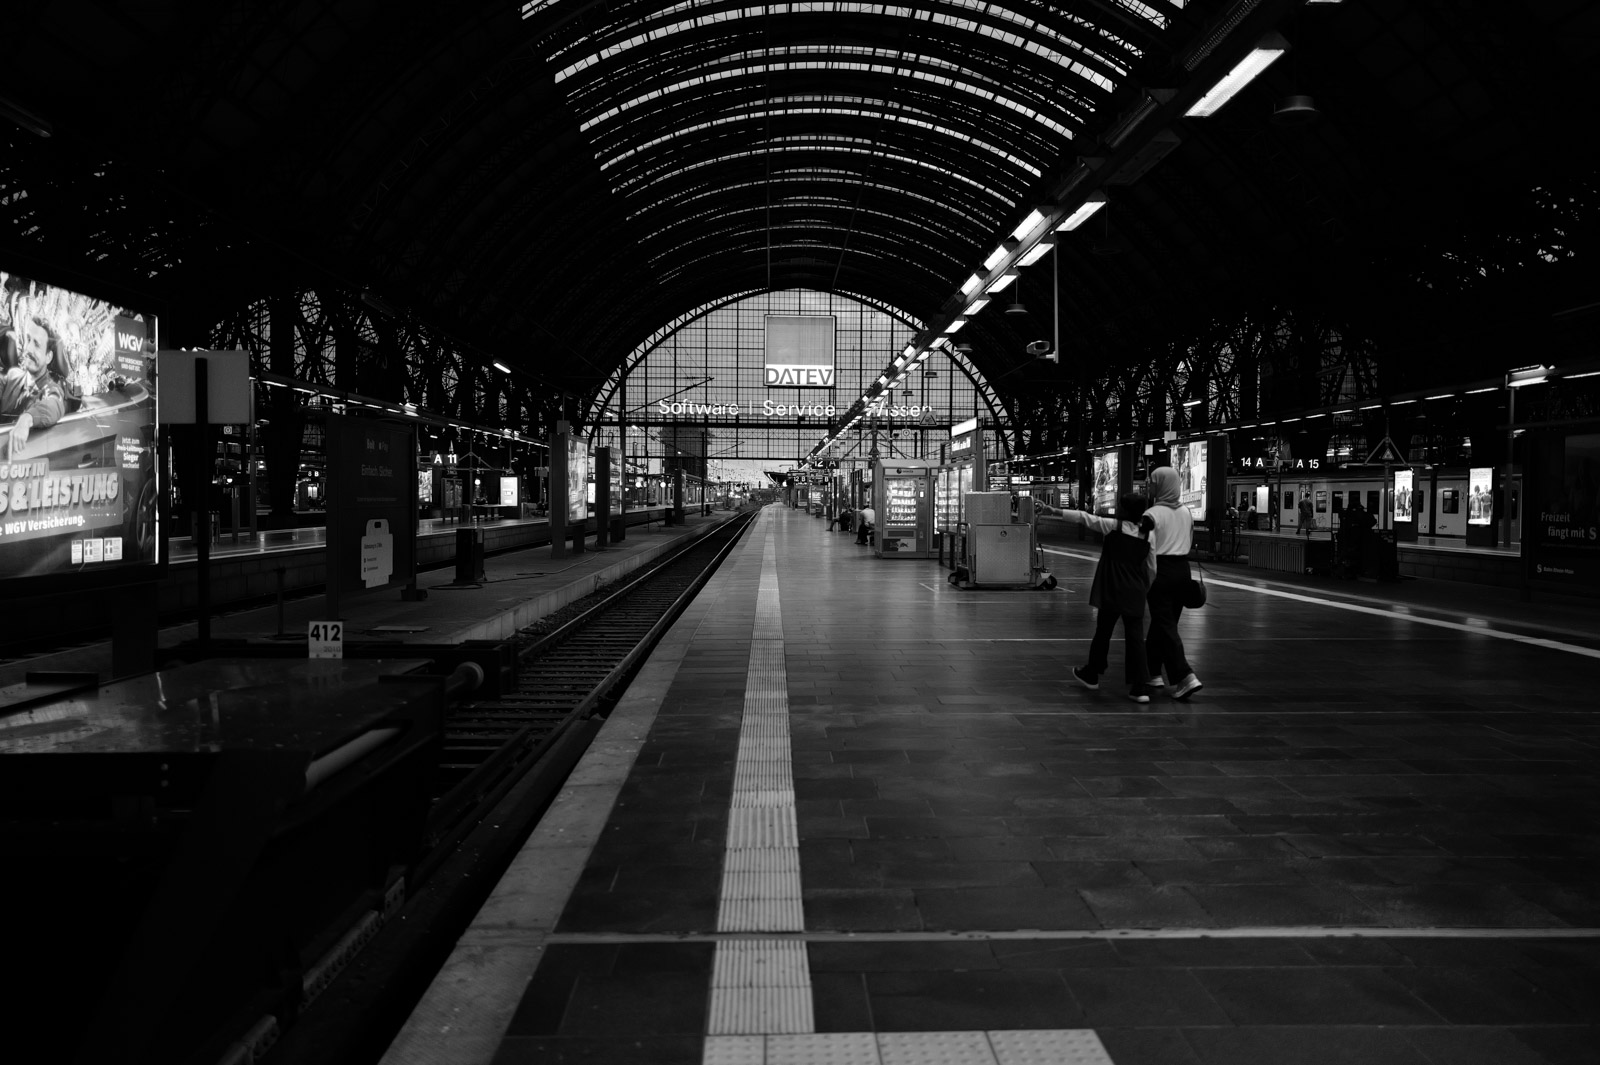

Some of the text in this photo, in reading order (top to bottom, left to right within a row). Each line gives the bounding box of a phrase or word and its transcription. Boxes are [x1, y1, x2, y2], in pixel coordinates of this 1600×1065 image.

[118, 332, 143, 352] WGV
[766, 368, 833, 385] DATEV
[659, 398, 739, 415] Software
[762, 400, 835, 417] Service
[433, 454, 457, 464] A 11
[1240, 457, 1264, 467] 14 A
[1296, 459, 1319, 469] A 15
[10, 463, 32, 479] GUT
[32, 462, 46, 477] IN
[10, 482, 28, 511] &
[31, 473, 118, 508] LEISTUNG
[5, 521, 27, 535] WGV
[28, 515, 86, 532] Versicherung.
[1541, 511, 1570, 523] Freizeit
[1548, 526, 1569, 540] fängt
[1570, 527, 1585, 538] mit
[310, 624, 341, 641] 412
